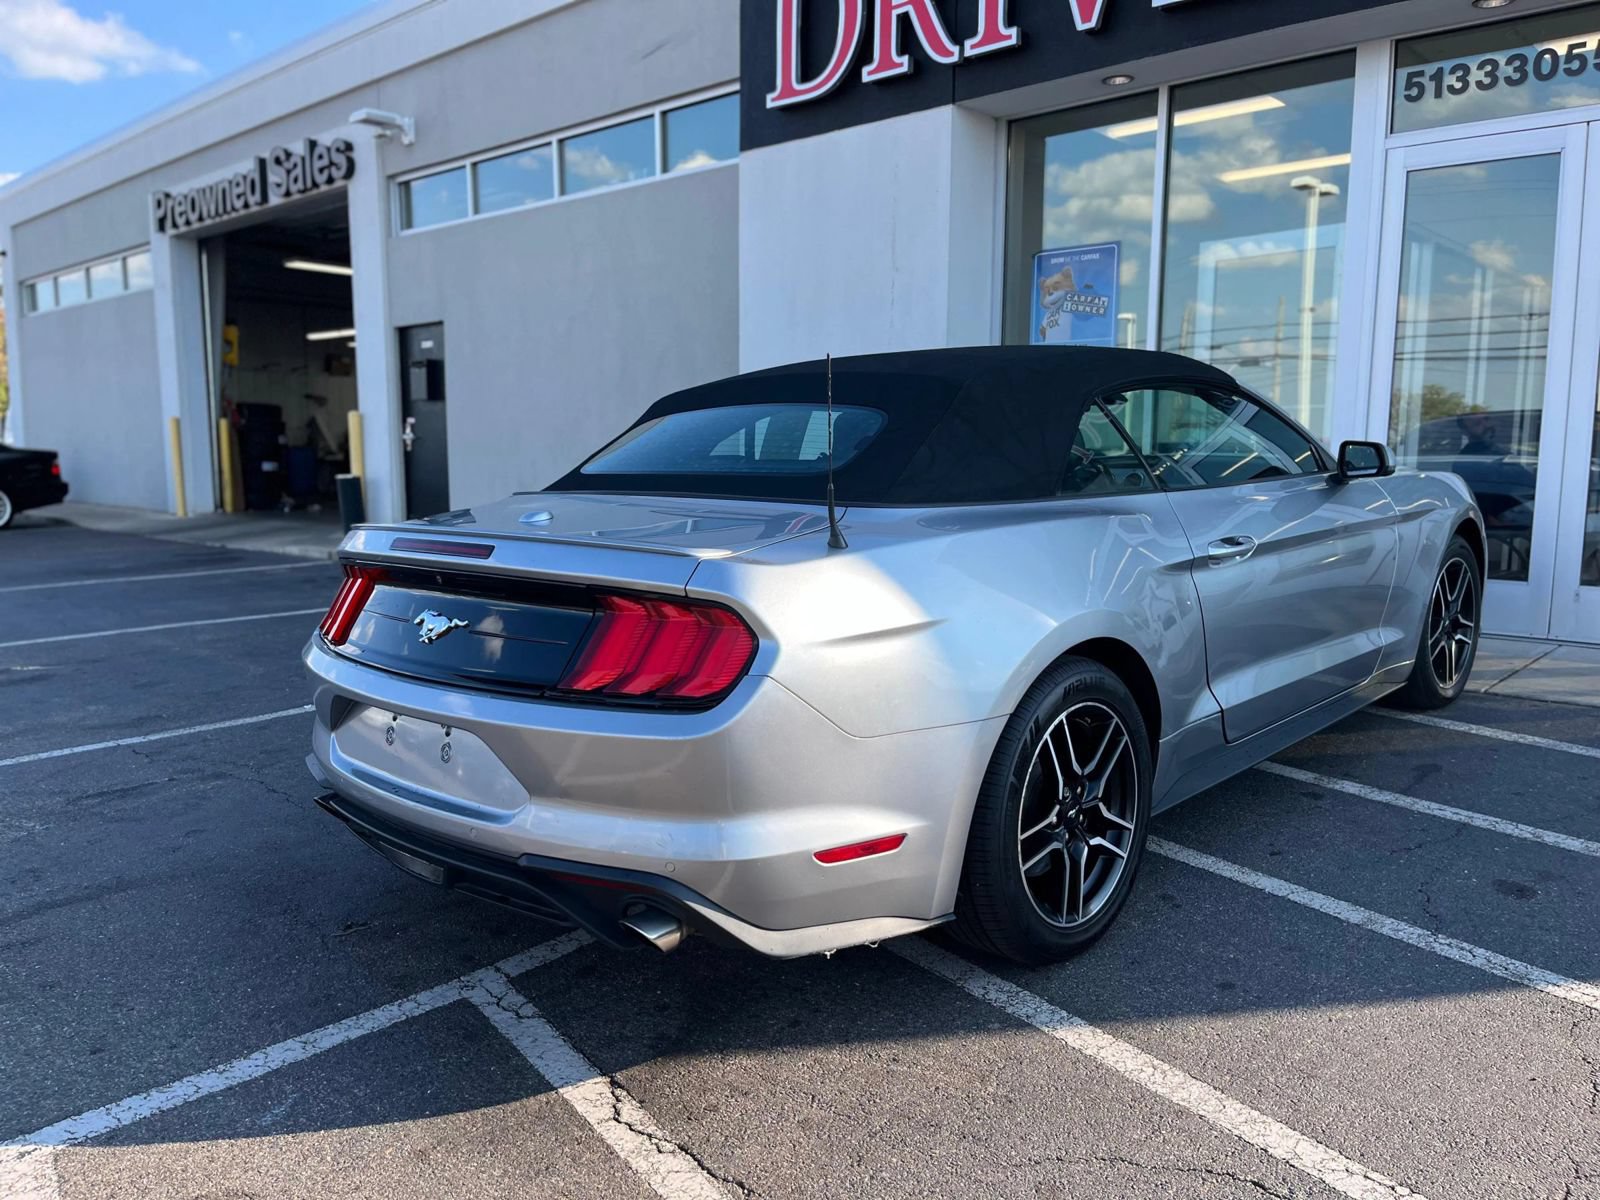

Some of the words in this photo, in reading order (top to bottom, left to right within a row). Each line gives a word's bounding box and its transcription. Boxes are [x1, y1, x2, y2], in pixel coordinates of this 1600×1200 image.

[152, 155, 268, 233] Preowned
[269, 137, 355, 198] Sales
[1071, 303, 1105, 315] OWNER
